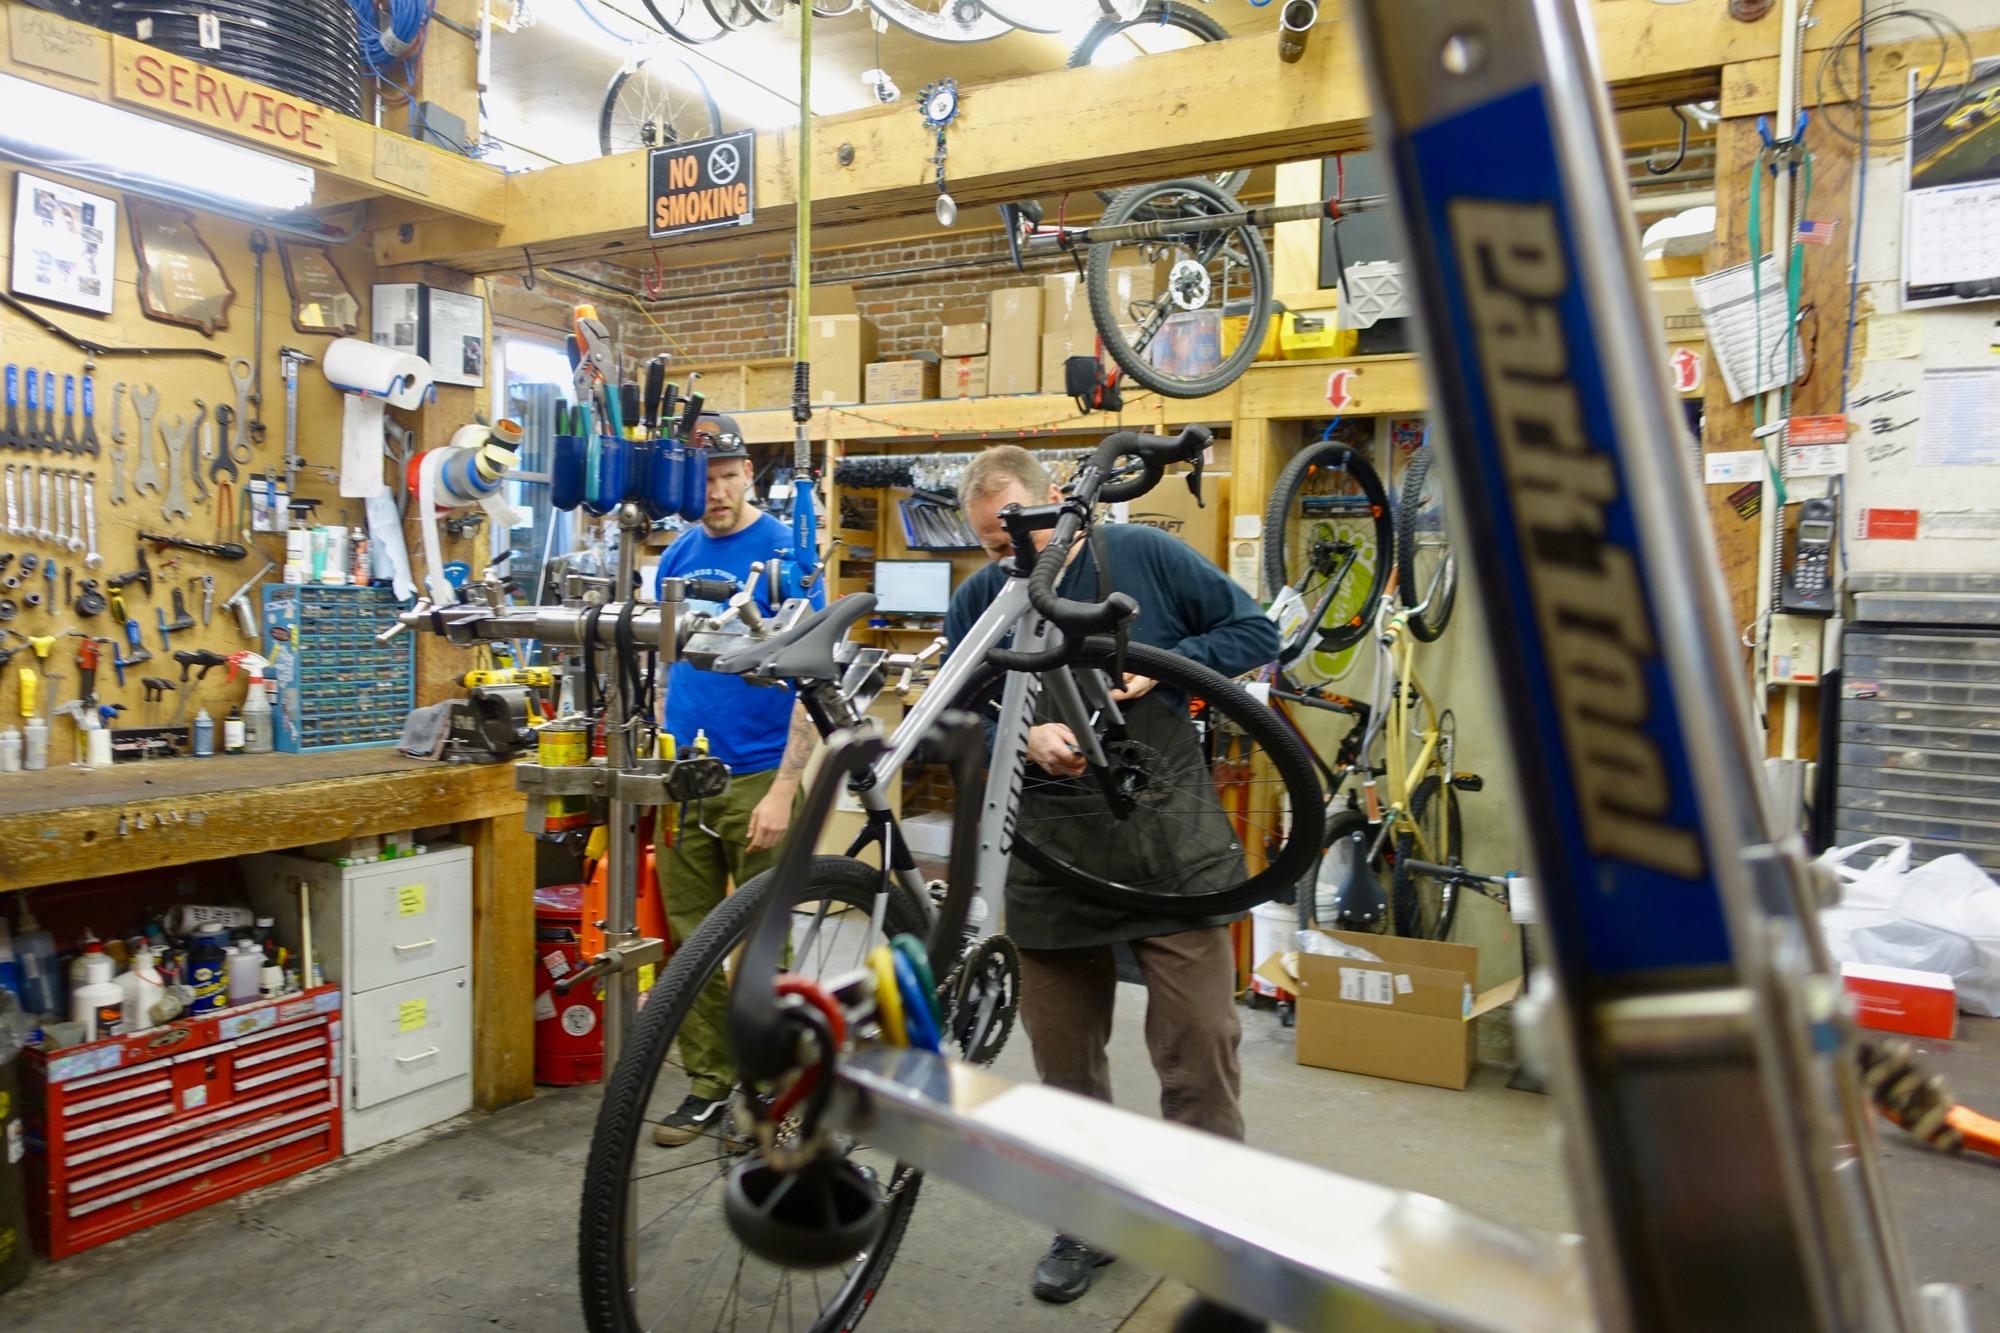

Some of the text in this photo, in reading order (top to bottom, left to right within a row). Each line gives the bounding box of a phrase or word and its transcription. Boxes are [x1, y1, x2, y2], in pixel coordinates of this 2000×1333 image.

[134, 55, 325, 151] SERVICE
[655, 183, 748, 229] SMOKING
[669, 155, 699, 189] NO
[1447, 199, 1705, 880] Park Tool
